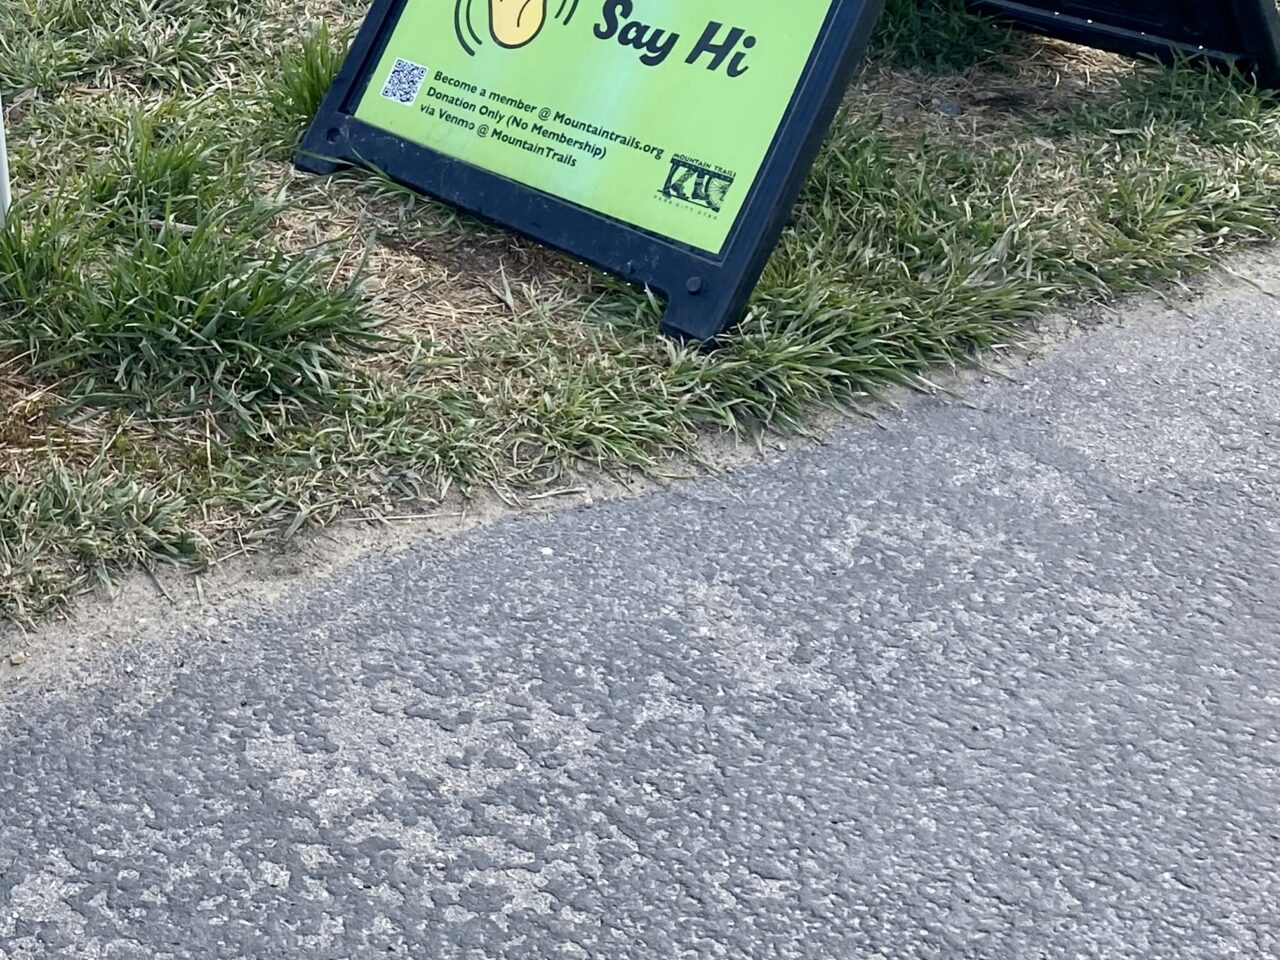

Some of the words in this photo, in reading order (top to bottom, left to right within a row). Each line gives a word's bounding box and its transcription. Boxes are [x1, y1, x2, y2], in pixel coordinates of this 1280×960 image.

[684, 21, 757, 78] Hi
[420, 104, 435, 116] via
[438, 108, 476, 130] Venmo
[477, 124, 490, 138] @
[491, 128, 577, 168] MountainTrails
[427, 87, 476, 112] Donation
[479, 104, 506, 123] Only
[506, 115, 529, 130] (No
[530, 124, 607, 160] Membership)
[433, 71, 477, 94] Become
[480, 88, 487, 97] a
[488, 90, 538, 114] member
[538, 107, 552, 120] @
[554, 111, 665, 160] Mountaintrails.org
[673, 153, 711, 169] MOUNTAIN
